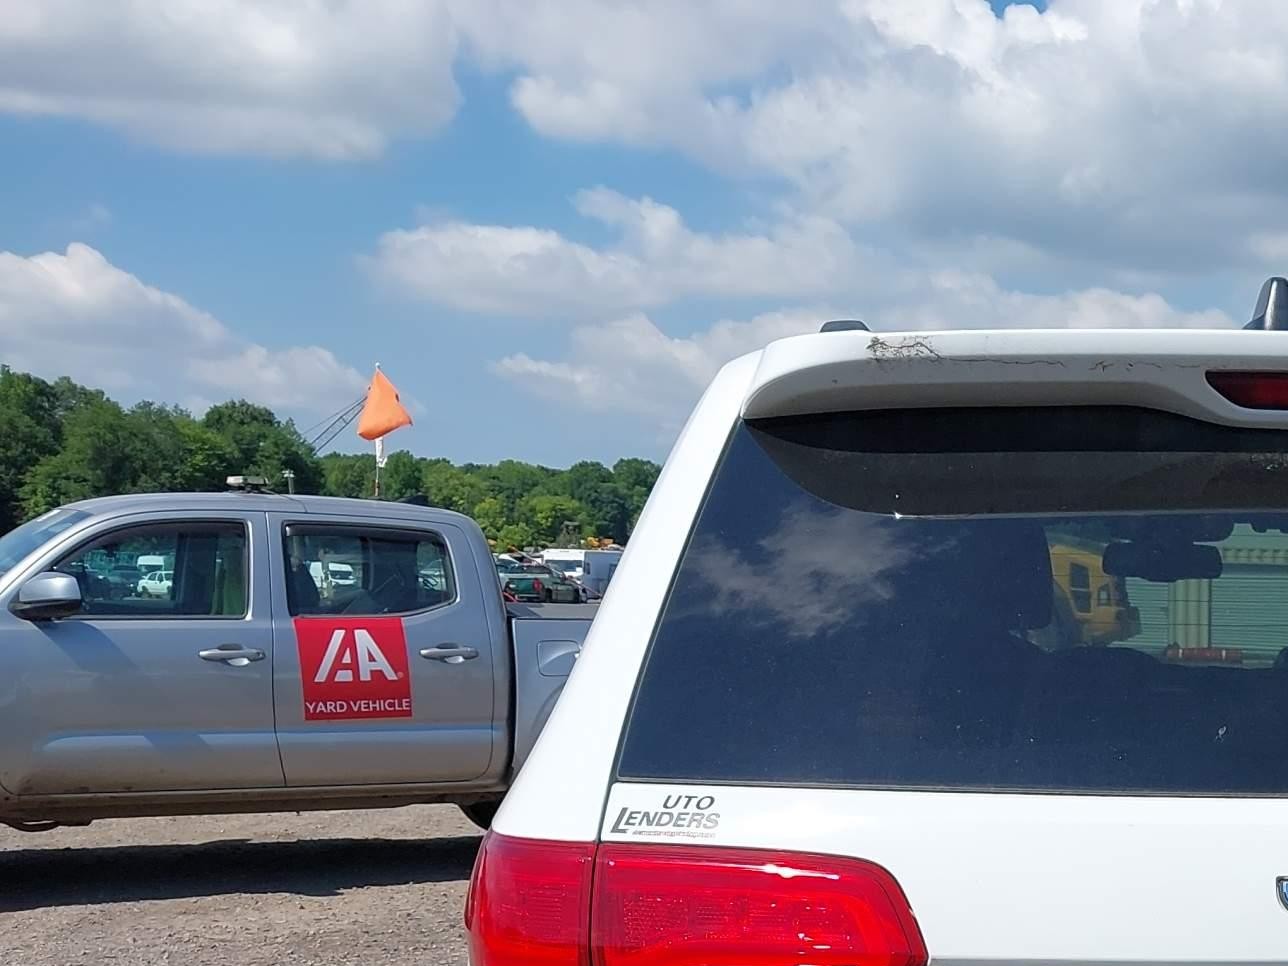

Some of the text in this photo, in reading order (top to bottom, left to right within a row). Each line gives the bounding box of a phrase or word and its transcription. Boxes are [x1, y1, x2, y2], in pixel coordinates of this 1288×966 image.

[305, 699, 411, 713] YARD VEHICLE
[663, 794, 715, 810] UTO
[610, 807, 721, 833] LENDERS
